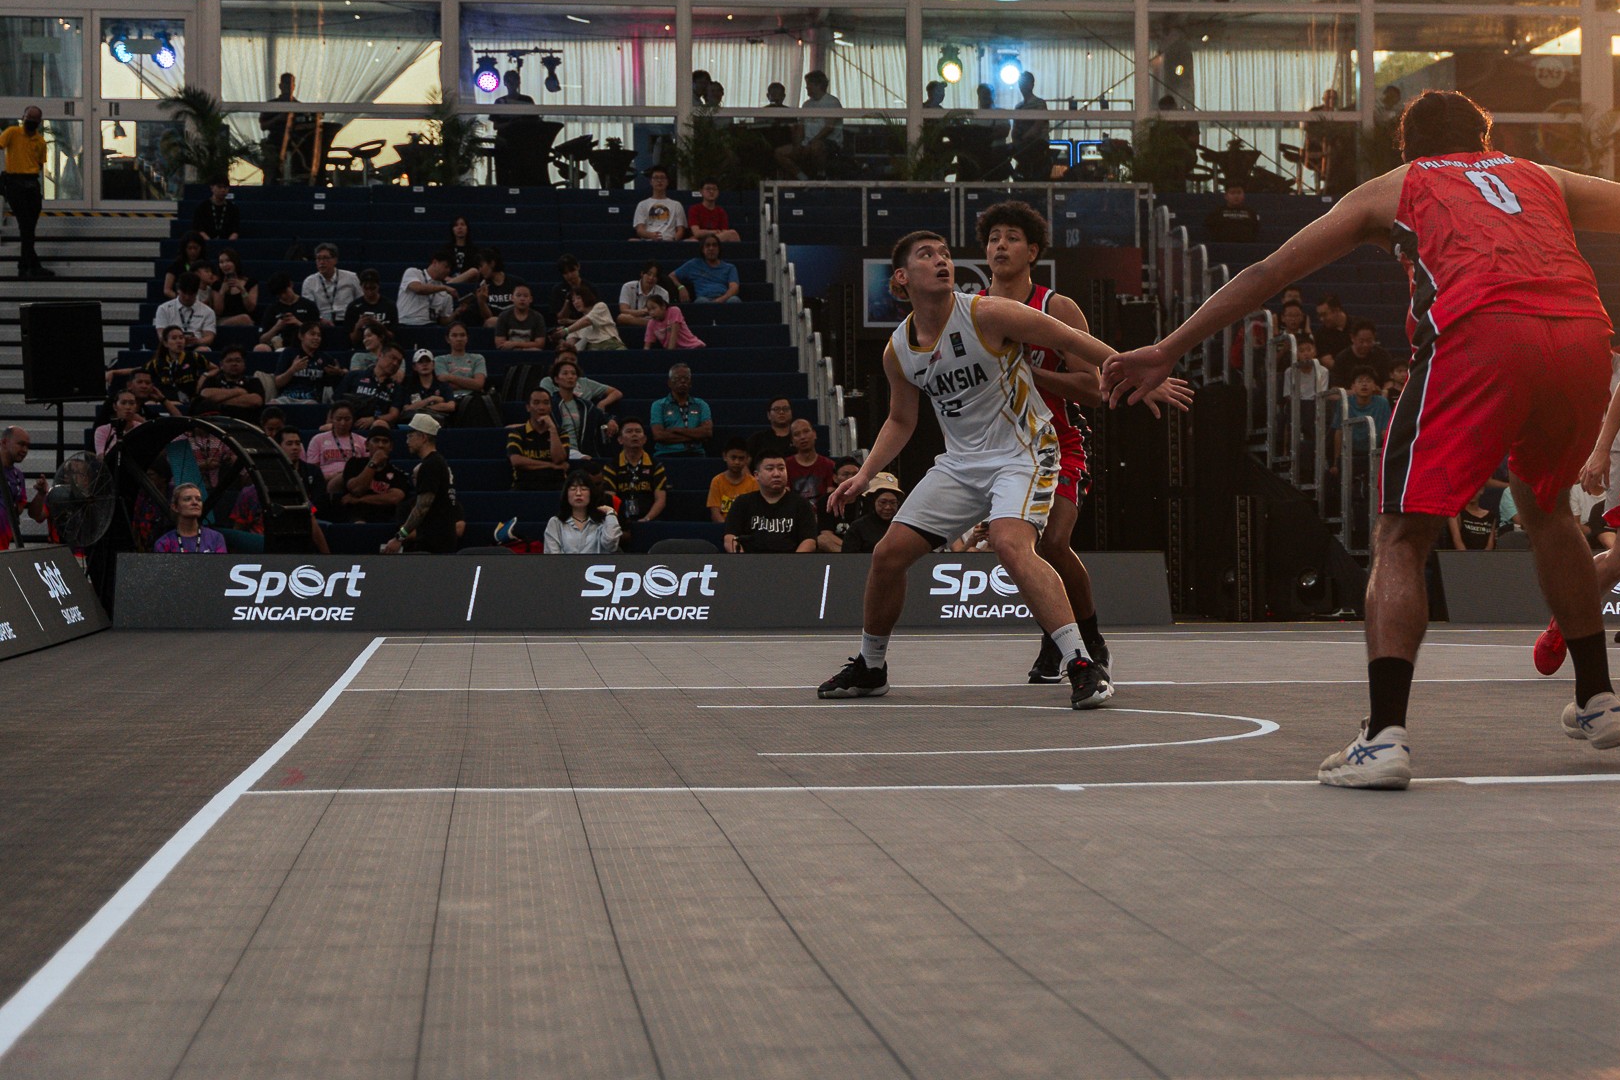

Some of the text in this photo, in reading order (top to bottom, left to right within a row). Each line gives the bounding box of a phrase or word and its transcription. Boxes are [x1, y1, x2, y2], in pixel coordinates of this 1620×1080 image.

[1463, 169, 1523, 215] 0
[224, 564, 366, 604] Sport
[581, 564, 718, 604] Sport
[929, 563, 1020, 602] Spo
[232, 606, 355, 621] SINGAPORE
[590, 606, 710, 621] SINGAPORE
[940, 604, 1033, 619] SINGAPO
